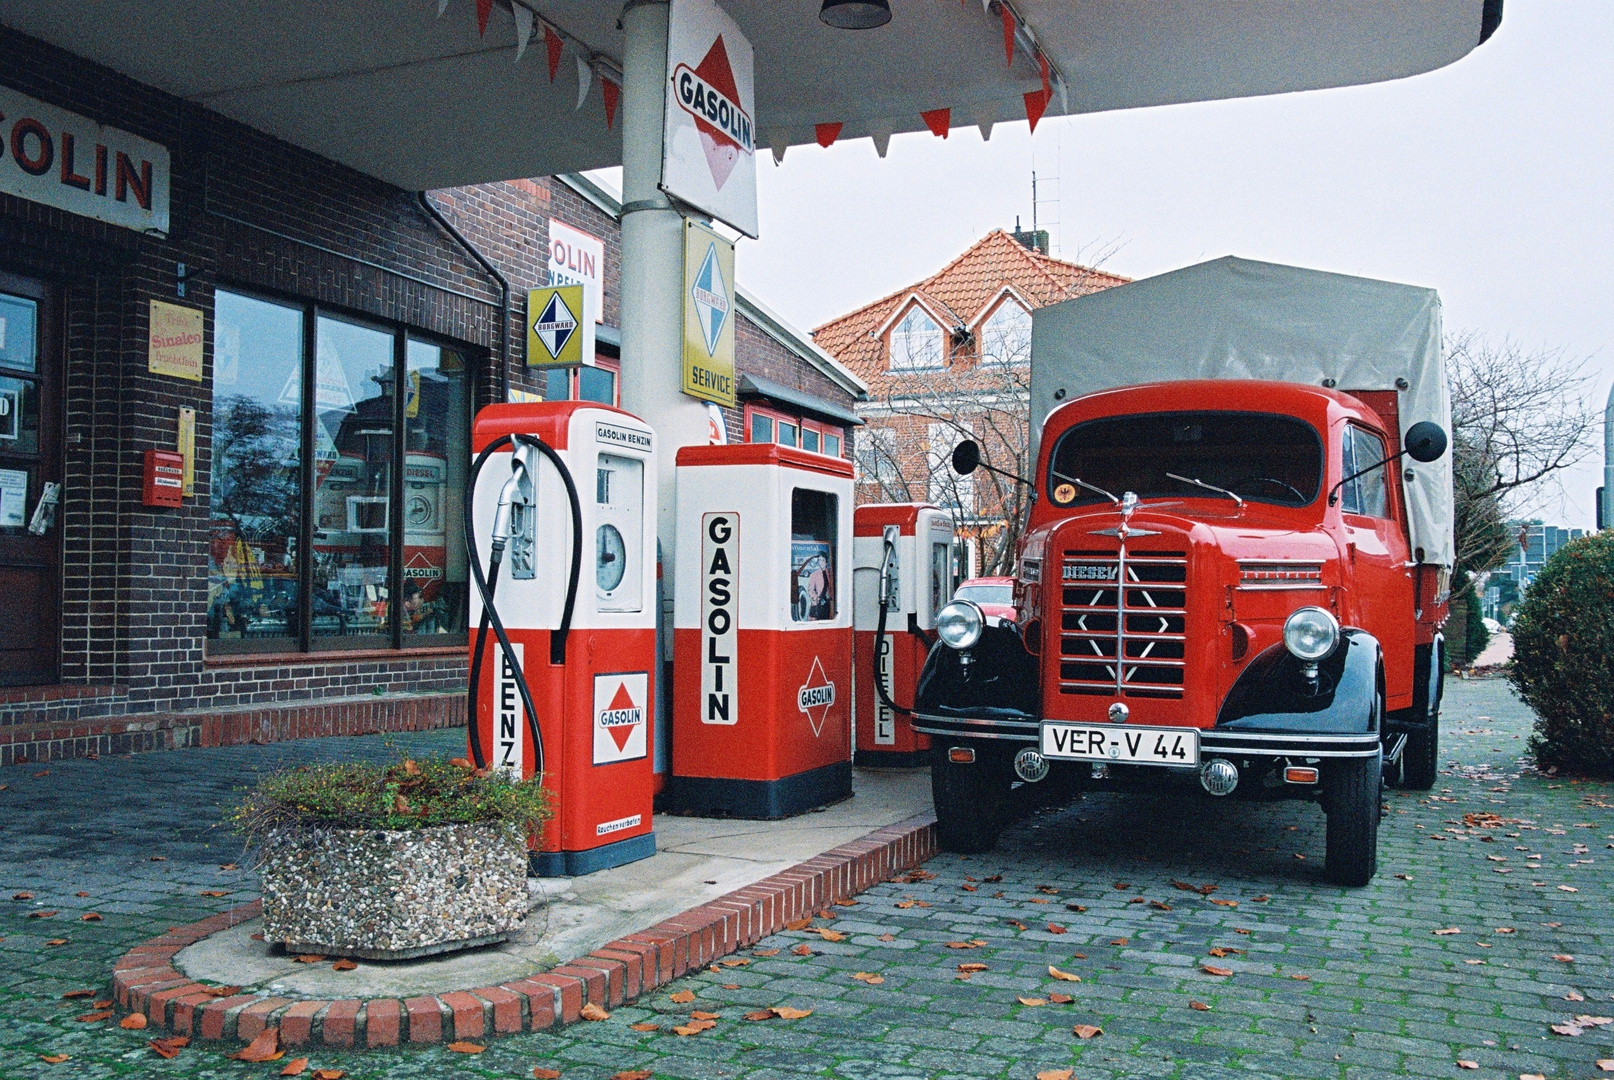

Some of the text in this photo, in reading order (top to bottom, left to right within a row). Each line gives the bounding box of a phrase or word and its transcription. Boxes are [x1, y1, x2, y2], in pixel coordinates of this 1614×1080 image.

[680, 72, 751, 150] GASOLIN
[0, 110, 153, 211] OLIN
[538, 321, 574, 331] BORGWARD
[152, 331, 202, 349] Sinalco
[692, 365, 731, 395] SERVICE
[597, 428, 651, 447] GASOLIN BENZIN
[406, 468, 436, 478] DIESEL
[1062, 565, 1116, 580] DIESEL
[707, 516, 732, 721] GASOLIN
[801, 687, 832, 706] GASOLIN
[601, 709, 641, 726] GASOLIN
[1153, 734, 1186, 760] 44
